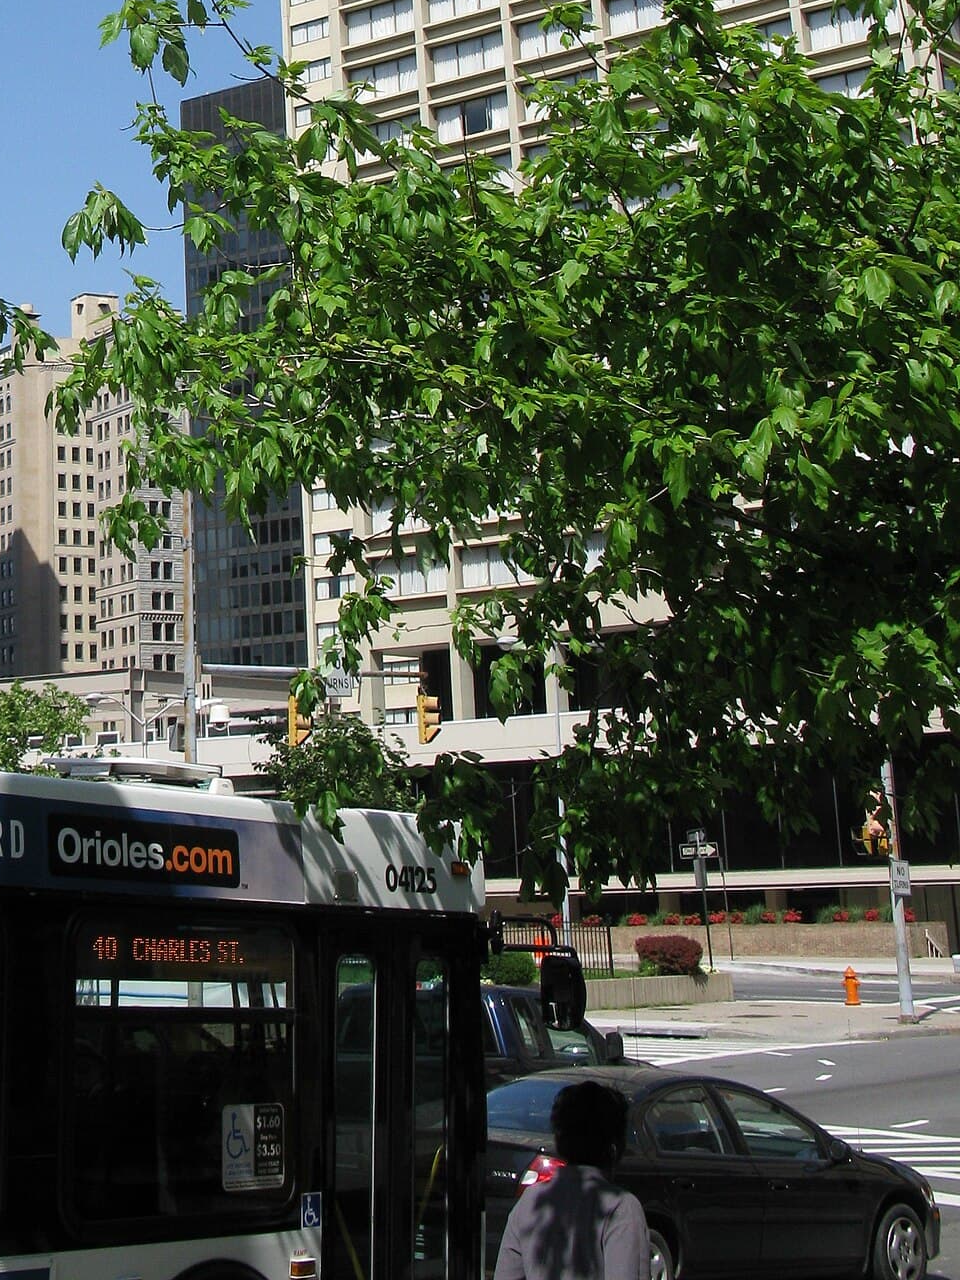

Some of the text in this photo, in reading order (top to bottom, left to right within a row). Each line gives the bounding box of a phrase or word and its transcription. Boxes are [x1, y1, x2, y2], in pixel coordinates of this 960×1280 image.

[57, 826, 233, 875] Orioles.com
[385, 864, 437, 895] 04125
[896, 866, 905, 876] NO
[93, 936, 244, 964] 40 CHARLES ST.
[256, 1143, 282, 1157] $3.50
